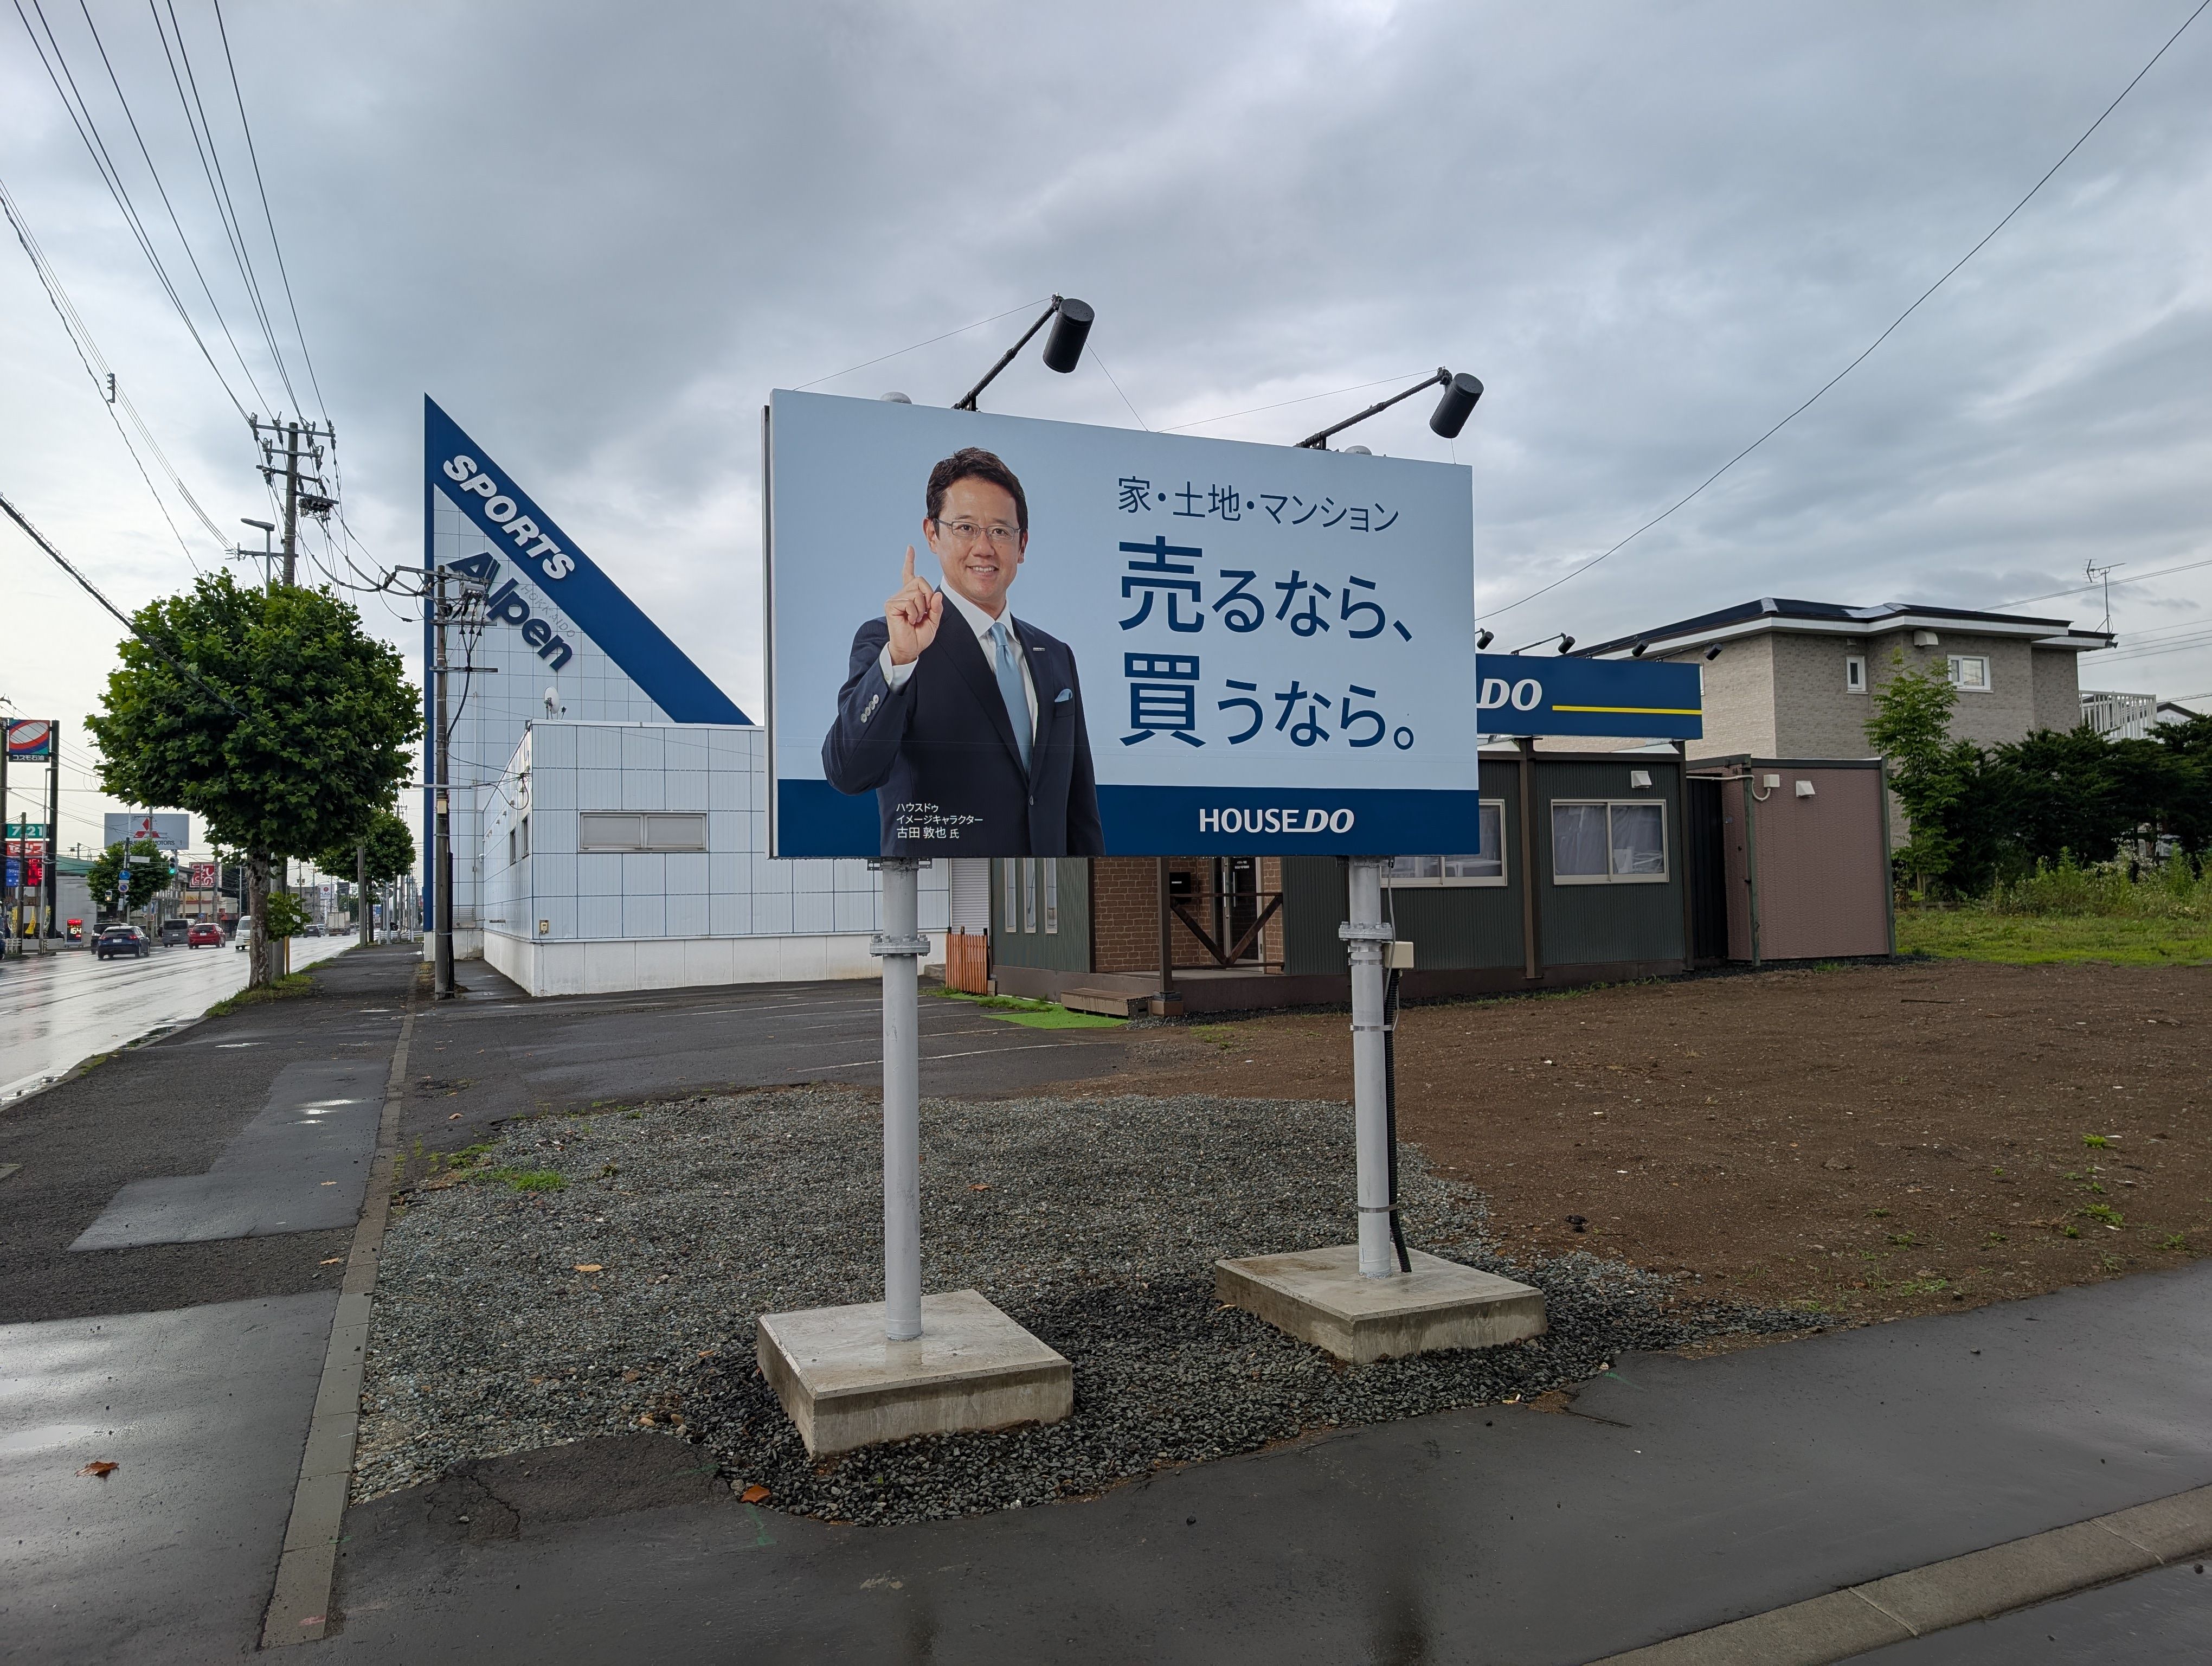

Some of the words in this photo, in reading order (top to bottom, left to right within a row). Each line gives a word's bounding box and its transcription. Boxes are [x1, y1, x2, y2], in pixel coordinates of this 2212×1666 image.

[443, 454, 575, 580] SPORTS
[1118, 476, 1399, 533] 家・土地・マンション
[446, 552, 573, 672] Alpen
[1118, 535, 1413, 642] 売るなら、
[1119, 652, 1414, 750] 買うなら。
[896, 802, 939, 813] ハウスドゥ
[896, 815, 983, 825] イメージキャラクター
